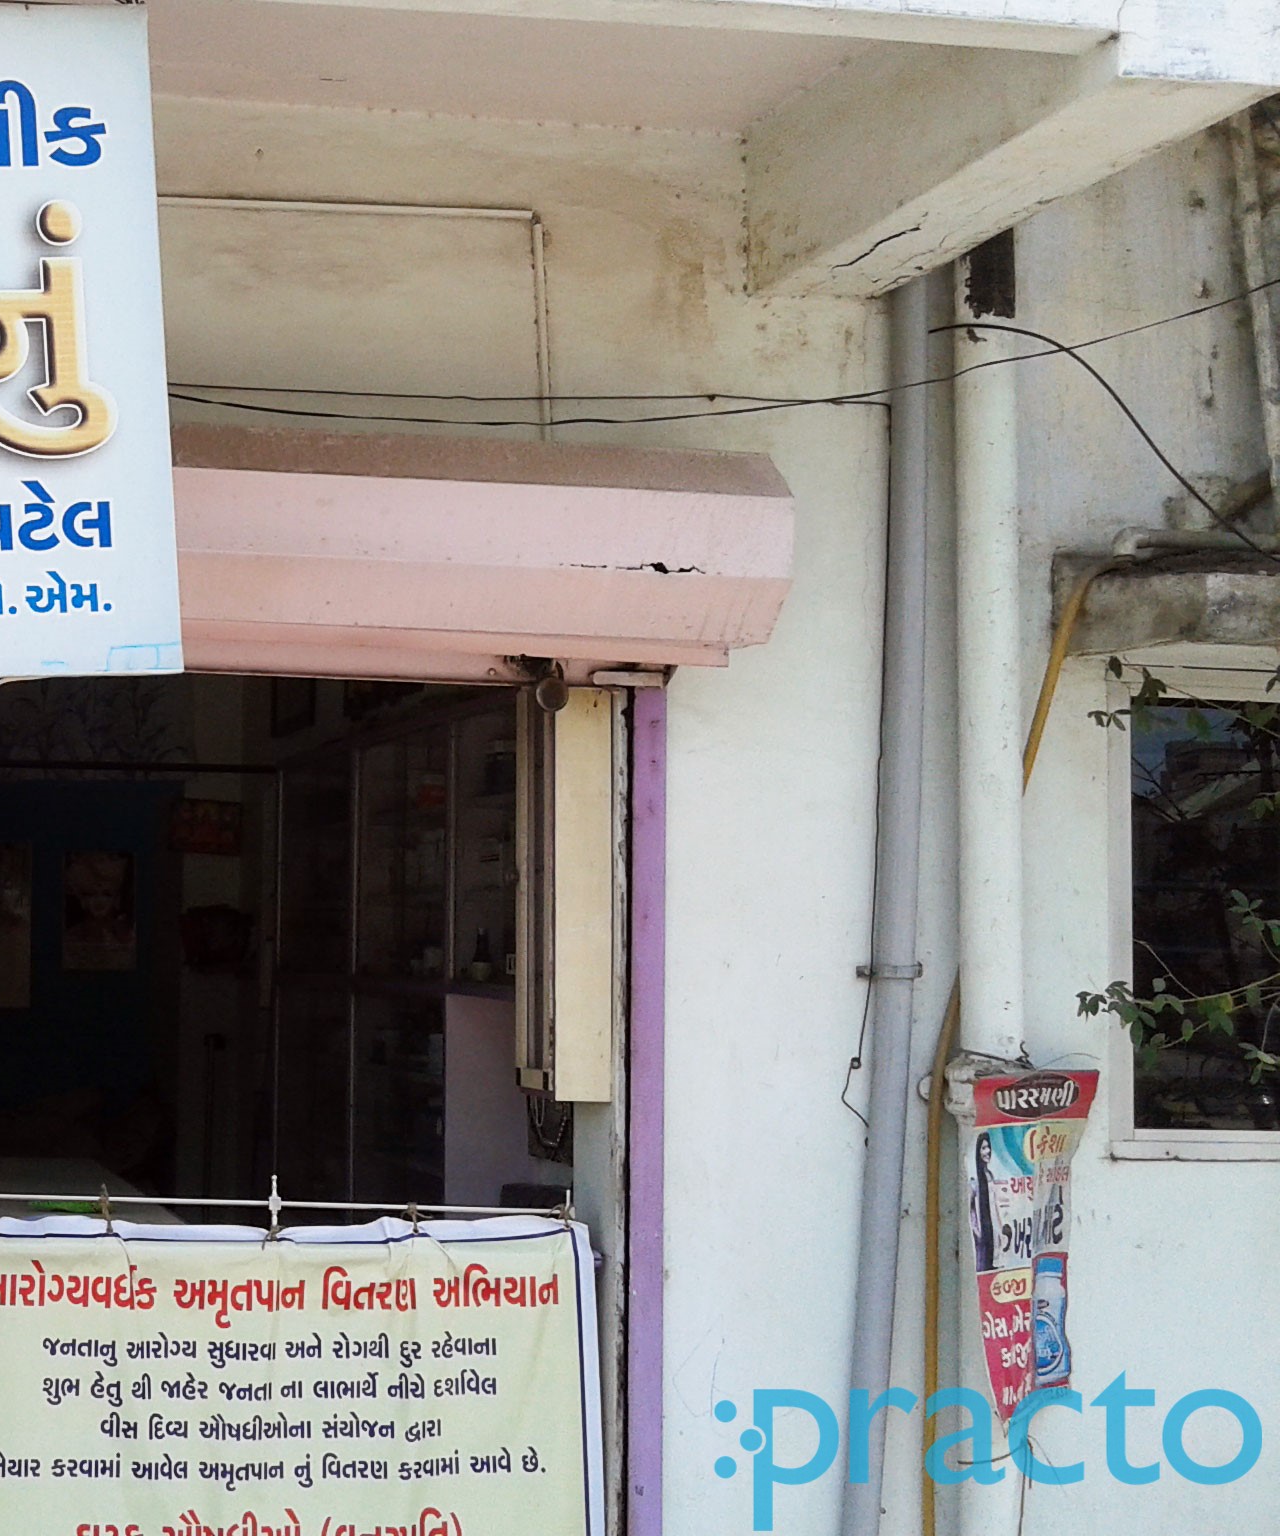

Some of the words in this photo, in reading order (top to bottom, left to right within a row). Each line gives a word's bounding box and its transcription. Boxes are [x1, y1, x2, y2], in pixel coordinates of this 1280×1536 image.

[173, 1279, 305, 1329] અમૃતપાન
[321, 1265, 416, 1312] વિતરણ
[433, 1263, 559, 1308] અભિયાન
[42, 1337, 118, 1367] જનતાનુ
[126, 1331, 197, 1359] આરોગ્ય
[207, 1340, 276, 1369] સુધારવા
[285, 1332, 322, 1359] અને
[332, 1331, 390, 1359] રોગથી
[399, 1340, 422, 1368] દુર
[431, 1330, 497, 1359] રહેવાના
[42, 1377, 80, 1406] શુભ
[90, 1370, 123, 1407] હેતુ
[131, 1372, 152, 1400] થી
[160, 1372, 208, 1401] જાહેર
[218, 1381, 272, 1402] જનતા
[280, 1380, 303, 1399] ના
[313, 1371, 379, 1399] લાભાર્થે
[387, 1372, 425, 1400] નીચે
[100, 1411, 138, 1440] વીસ
[148, 1413, 188, 1441] દિવ્ય
[321, 1411, 395, 1439] સંયોજન
[404, 1418, 442, 1443] દ્વારા
[51, 1452, 121, 1478] કરવામાં
[131, 1453, 188, 1481] આવેલ
[198, 1460, 284, 1492] અમૃતપાન
[294, 1453, 314, 1488] નું
[322, 1452, 388, 1480] વિતરણ
[398, 1449, 460, 1481] કરવામાં
[469, 1447, 512, 1474] આવે
[521, 1447, 546, 1474] છે.
